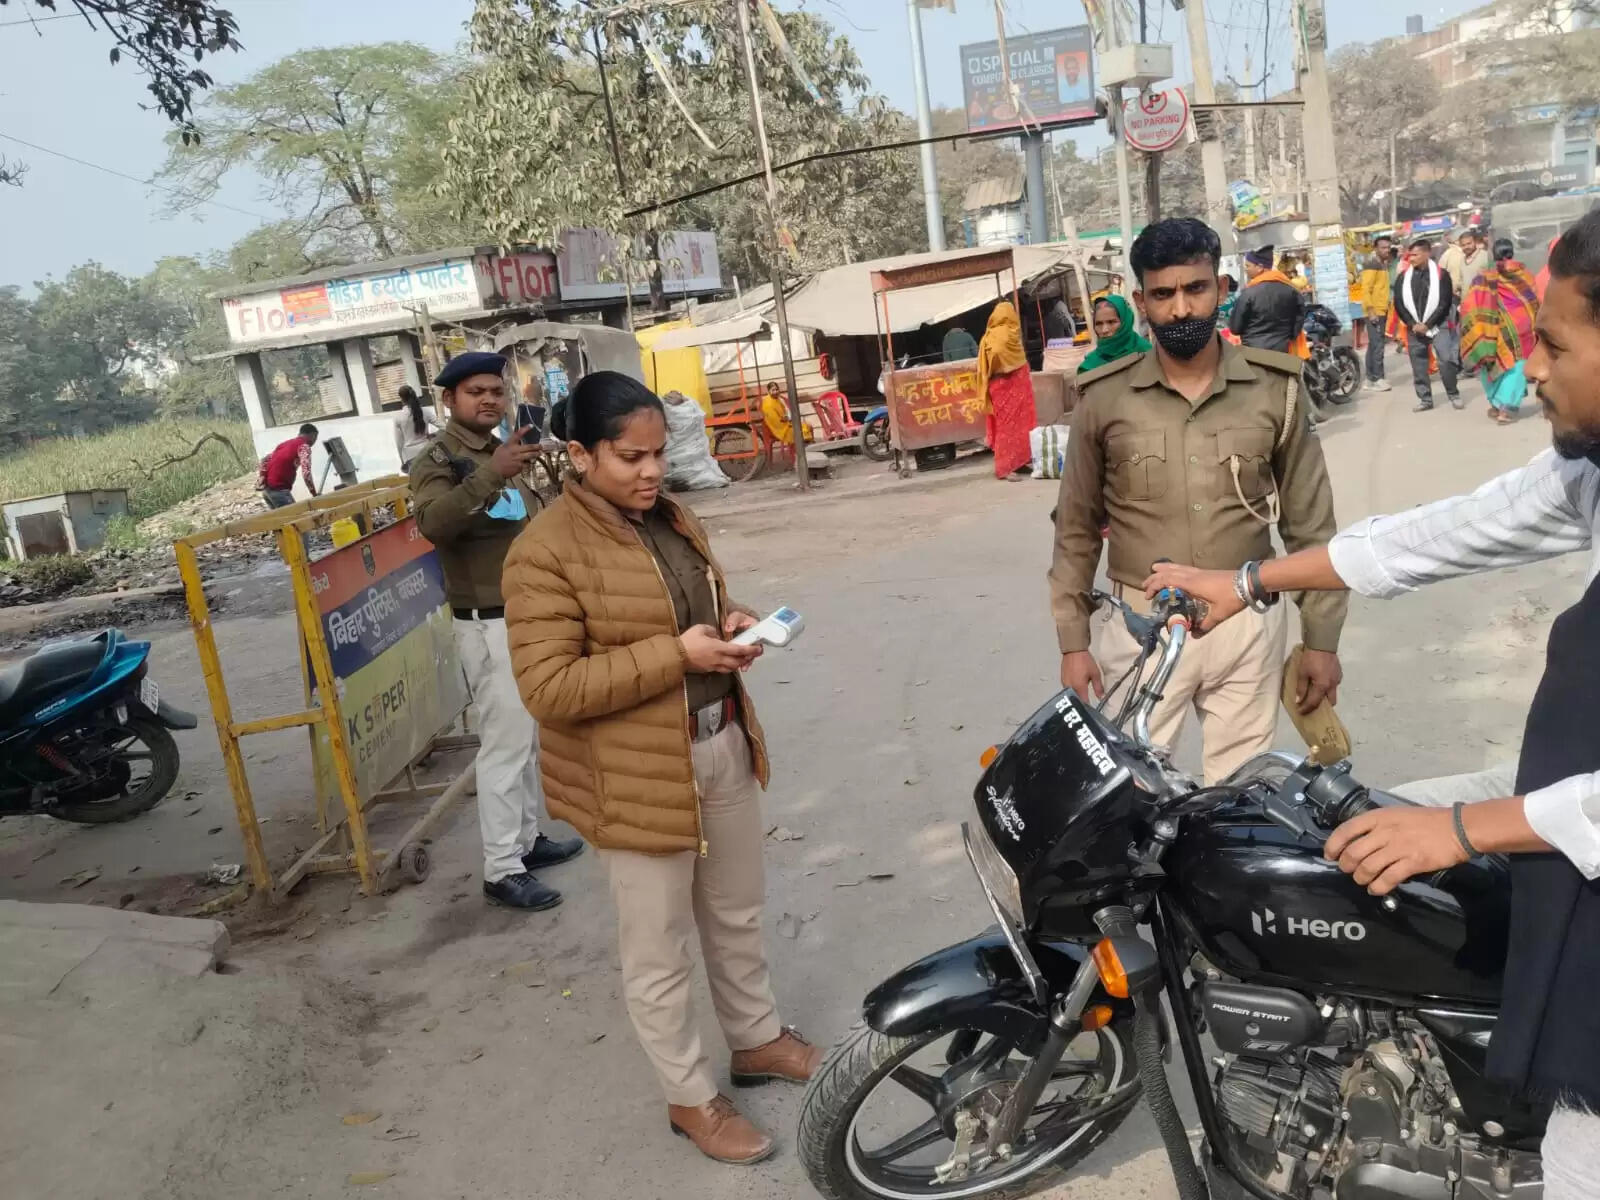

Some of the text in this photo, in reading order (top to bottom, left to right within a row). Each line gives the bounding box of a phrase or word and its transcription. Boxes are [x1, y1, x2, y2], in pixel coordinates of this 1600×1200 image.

[1144, 114, 1180, 127] PARKING
[238, 306, 286, 337] Flo
[328, 609, 367, 652] बिहार
[1287, 916, 1366, 941] Hero
[1212, 1003, 1291, 1022] POWER START
